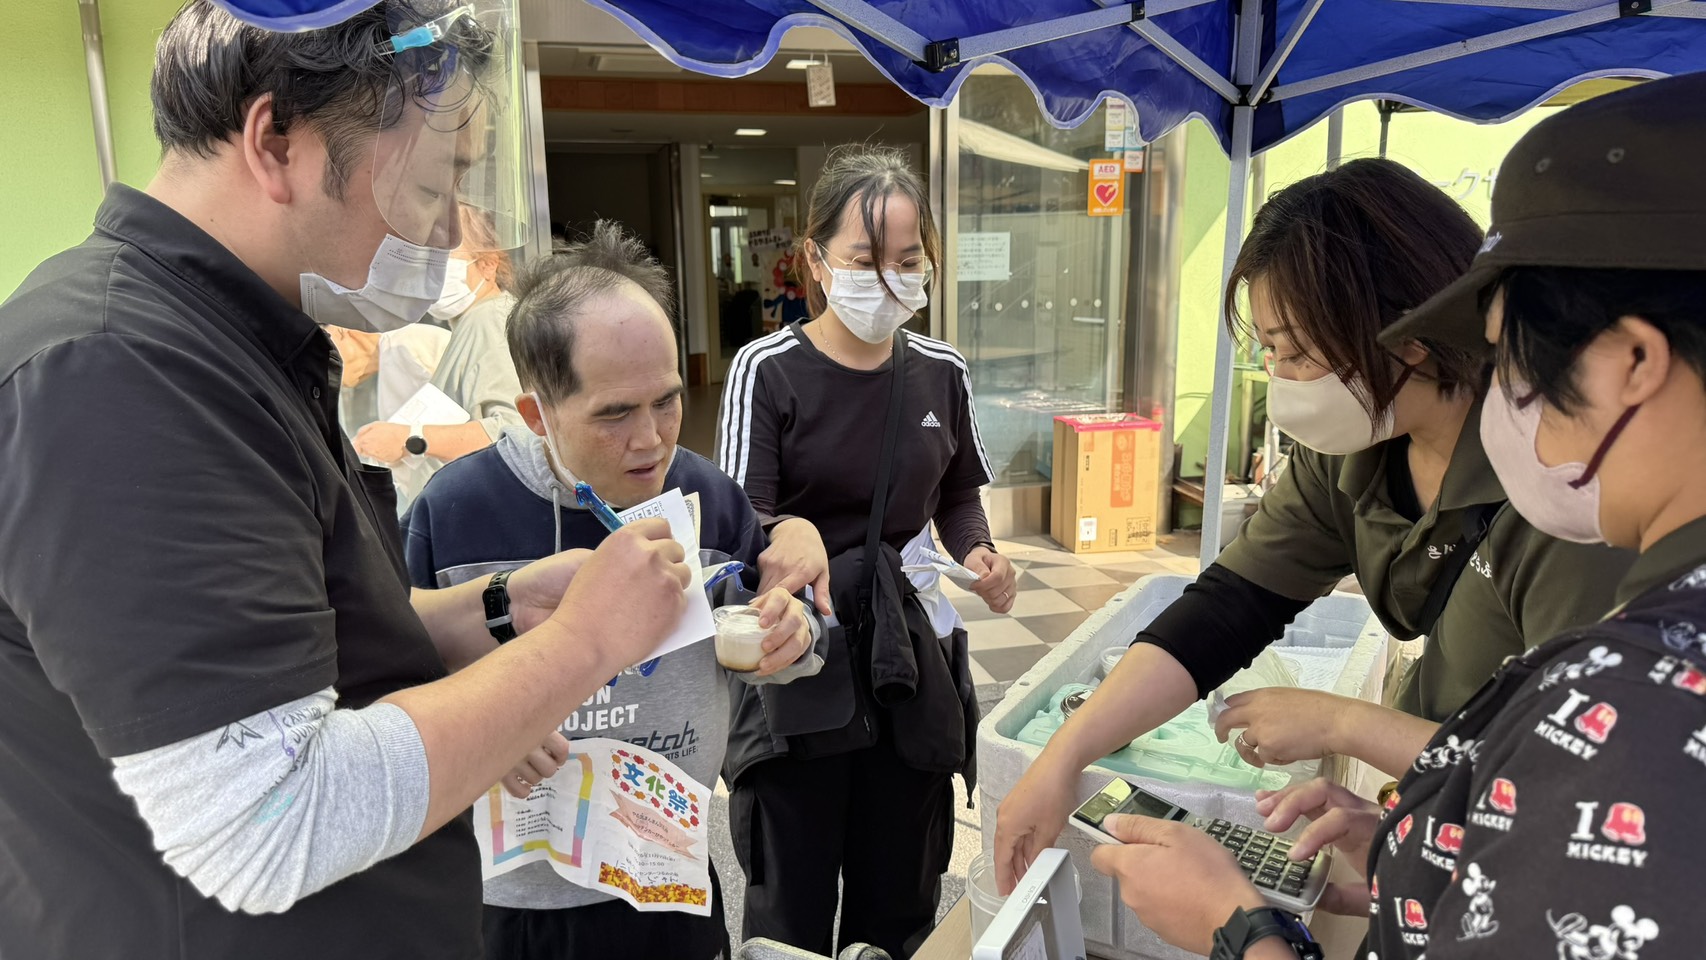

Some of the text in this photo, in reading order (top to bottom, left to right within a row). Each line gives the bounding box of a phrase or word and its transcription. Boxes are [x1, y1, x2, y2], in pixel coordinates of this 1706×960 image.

[1098, 165, 1115, 174] AED
[557, 704, 639, 732] OJECT
[1547, 688, 1590, 726] I
[1534, 720, 1598, 760] MICKEY
[623, 761, 689, 815] 文化祭
[1423, 815, 1436, 847] I
[1570, 801, 1599, 841] I
[1421, 847, 1456, 872] MICKE
[1566, 841, 1648, 868] MICKEY
[1394, 897, 1405, 928] I
